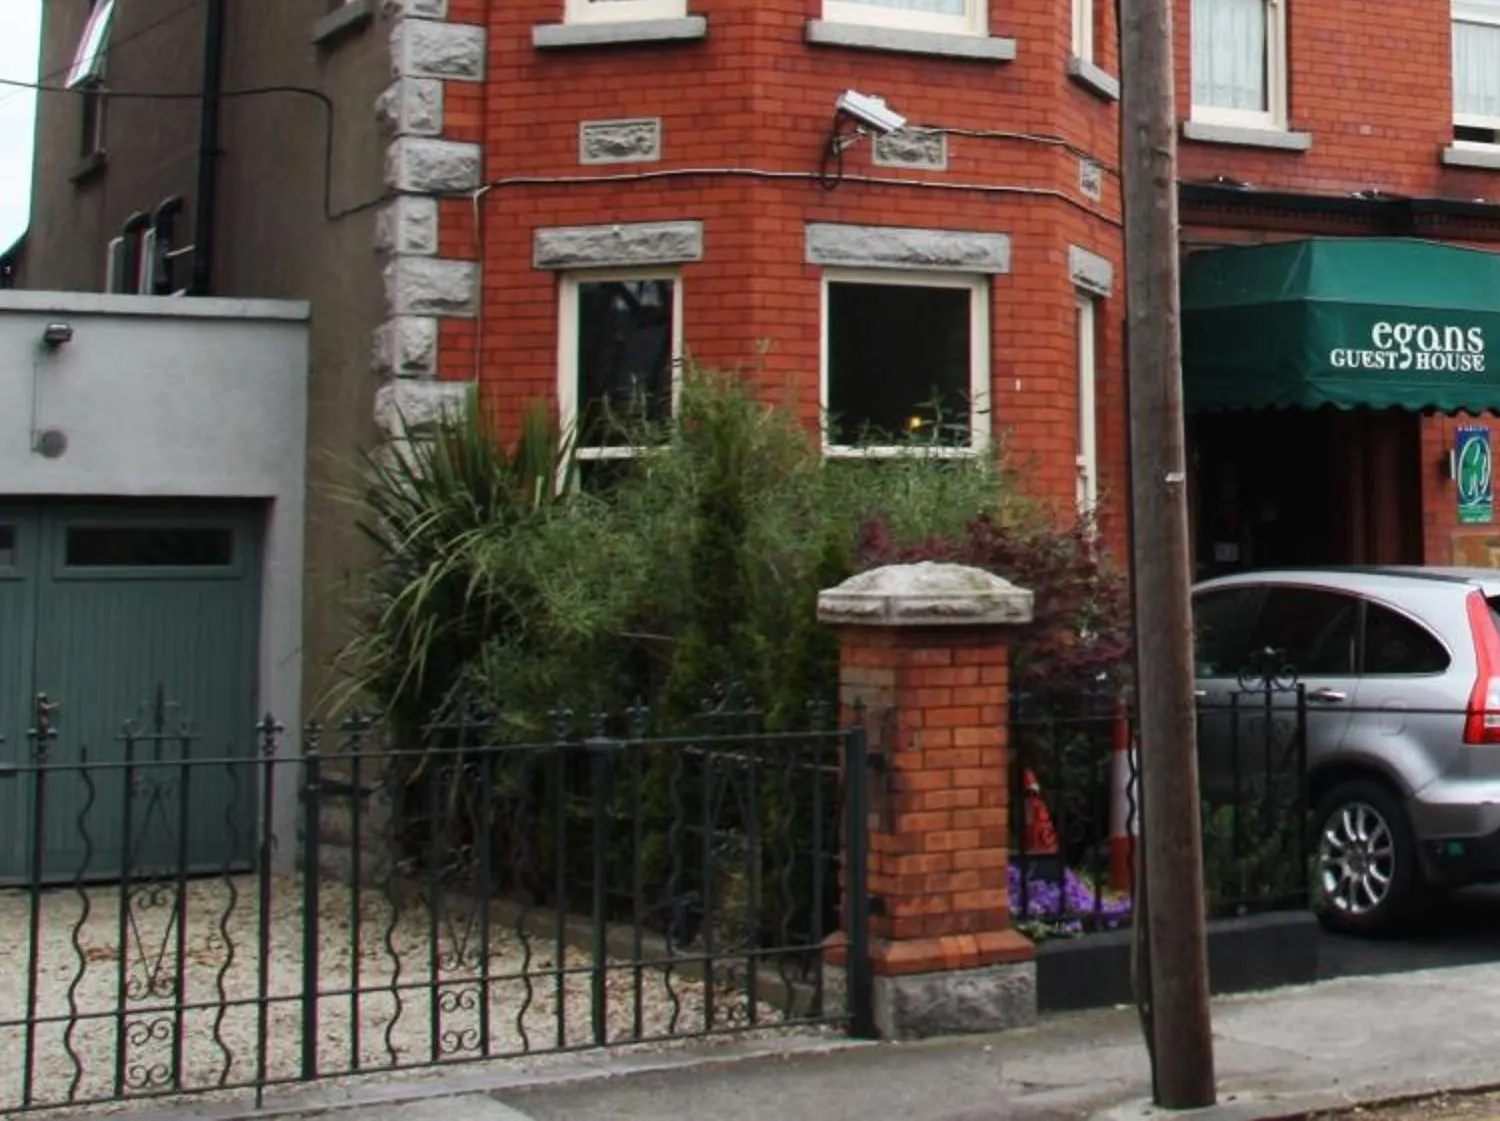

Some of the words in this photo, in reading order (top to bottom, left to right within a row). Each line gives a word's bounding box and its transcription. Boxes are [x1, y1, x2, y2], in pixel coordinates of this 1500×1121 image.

[1330, 348, 1398, 369] GUEST
[1415, 351, 1485, 371] HOUSE
[1372, 321, 1484, 370] egans
